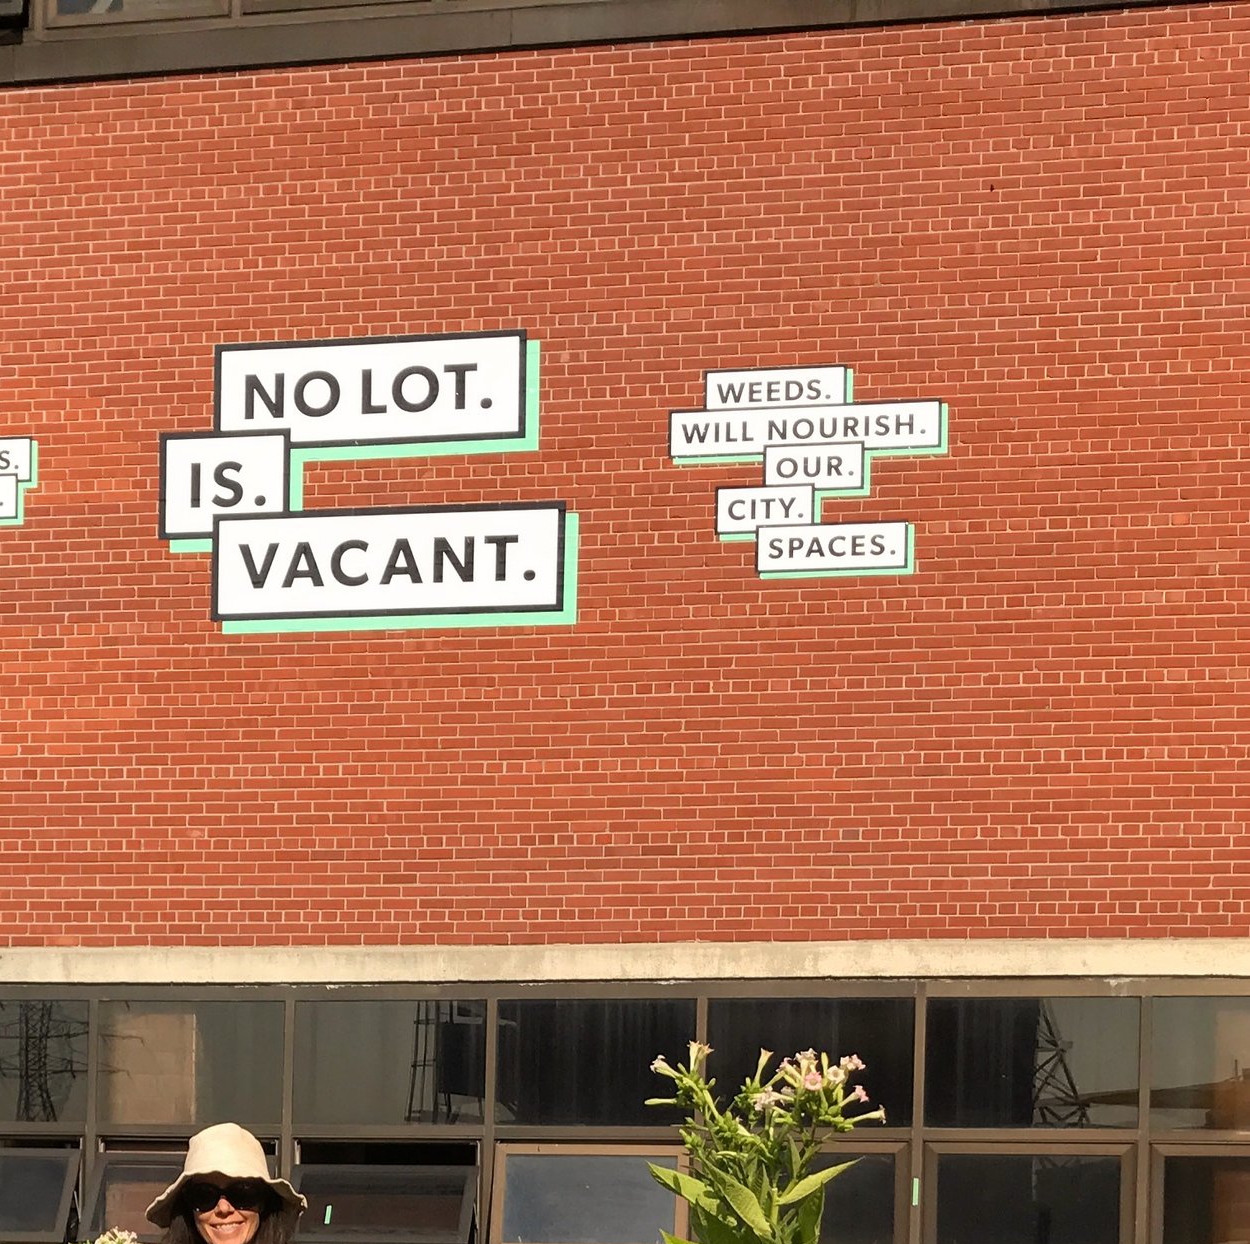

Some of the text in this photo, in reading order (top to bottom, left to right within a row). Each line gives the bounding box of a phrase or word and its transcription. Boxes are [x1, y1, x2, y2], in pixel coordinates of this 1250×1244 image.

[244, 363, 493, 420] NO LOT.
[716, 378, 832, 404] WEEDS.
[681, 413, 927, 445] WILL NOURISH.
[776, 455, 855, 479] OUR.
[190, 460, 267, 509] IS.
[727, 496, 804, 521] CITY.
[238, 534, 537, 589] VACANT.
[767, 534, 896, 560] SPACES.
